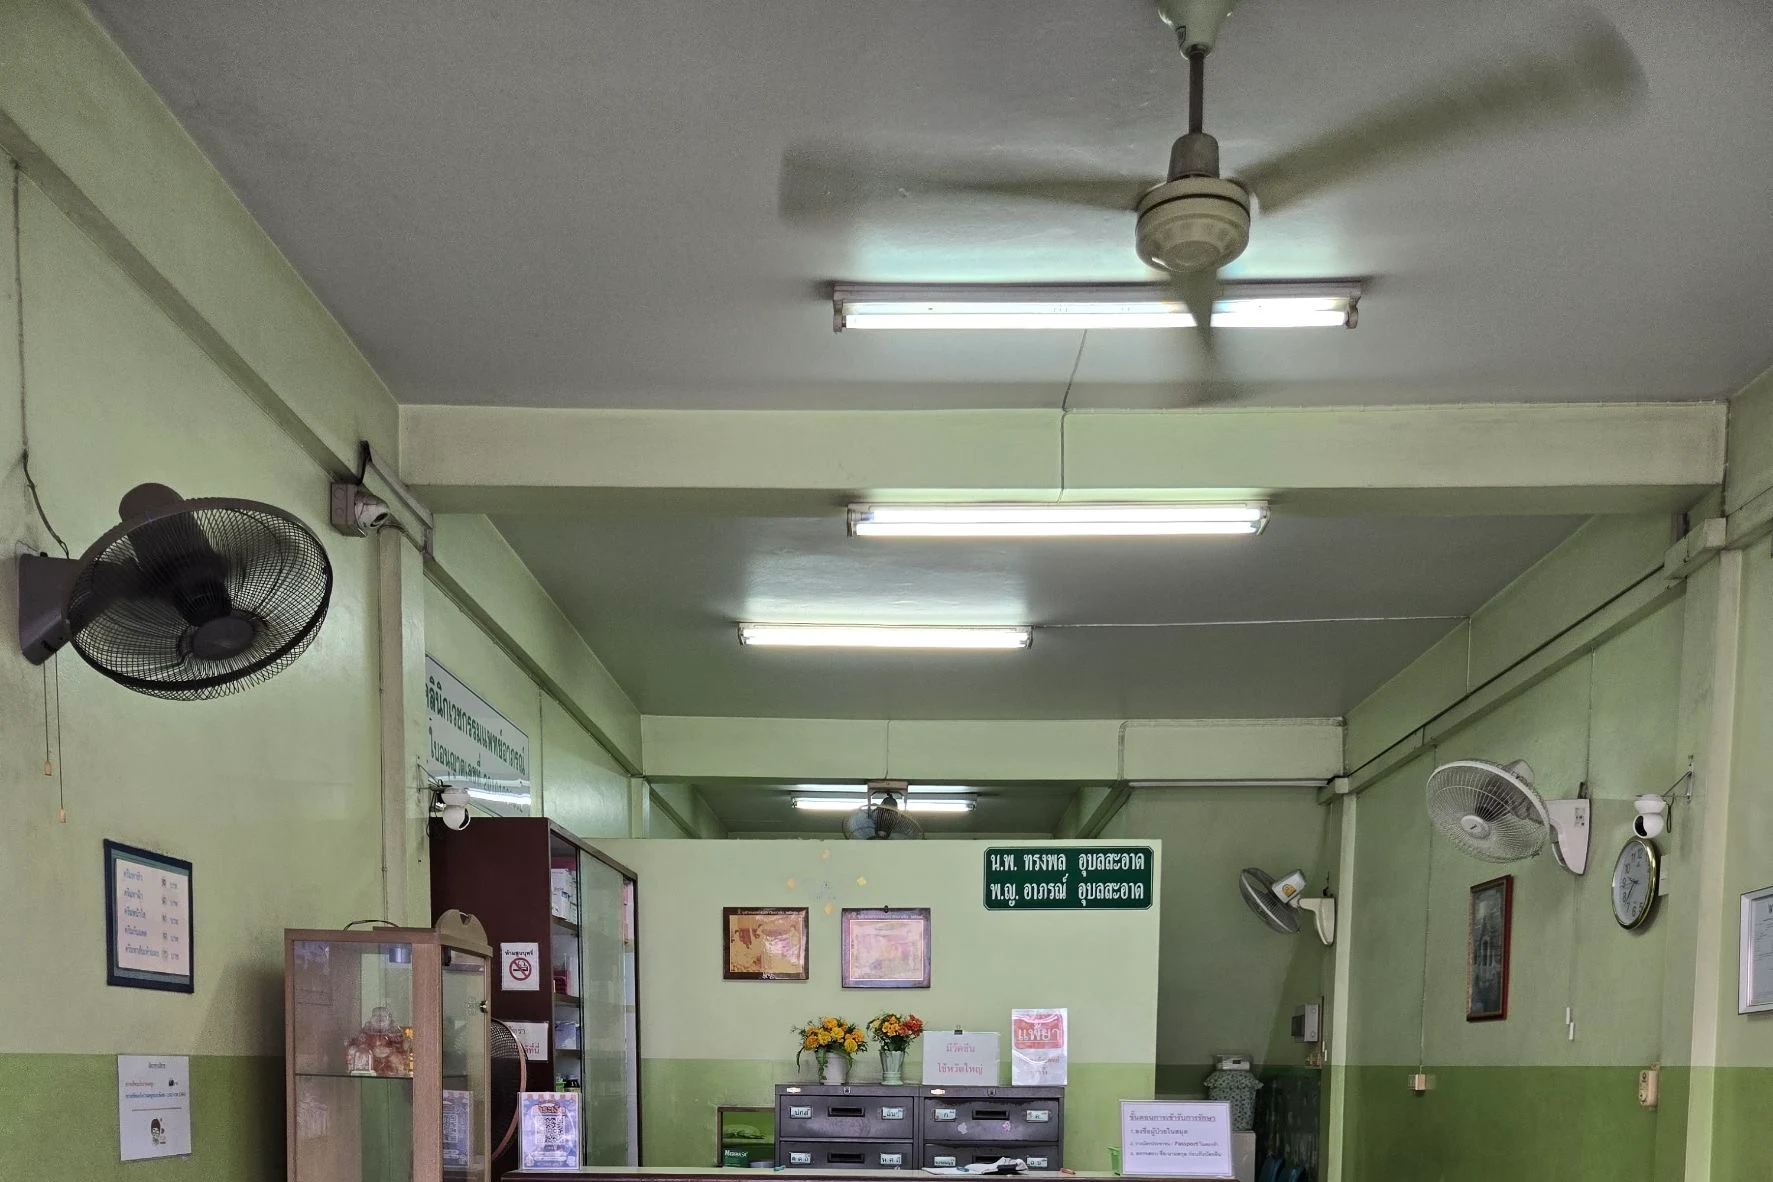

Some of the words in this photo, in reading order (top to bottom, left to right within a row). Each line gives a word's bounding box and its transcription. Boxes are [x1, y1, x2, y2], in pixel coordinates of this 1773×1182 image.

[1023, 853, 1066, 871] ทรงพล
[1078, 852, 1145, 877] อุบลสะอาด
[1023, 873, 1069, 900] อาภรณ์
[1077, 882, 1144, 907] อุบลสะอาด
